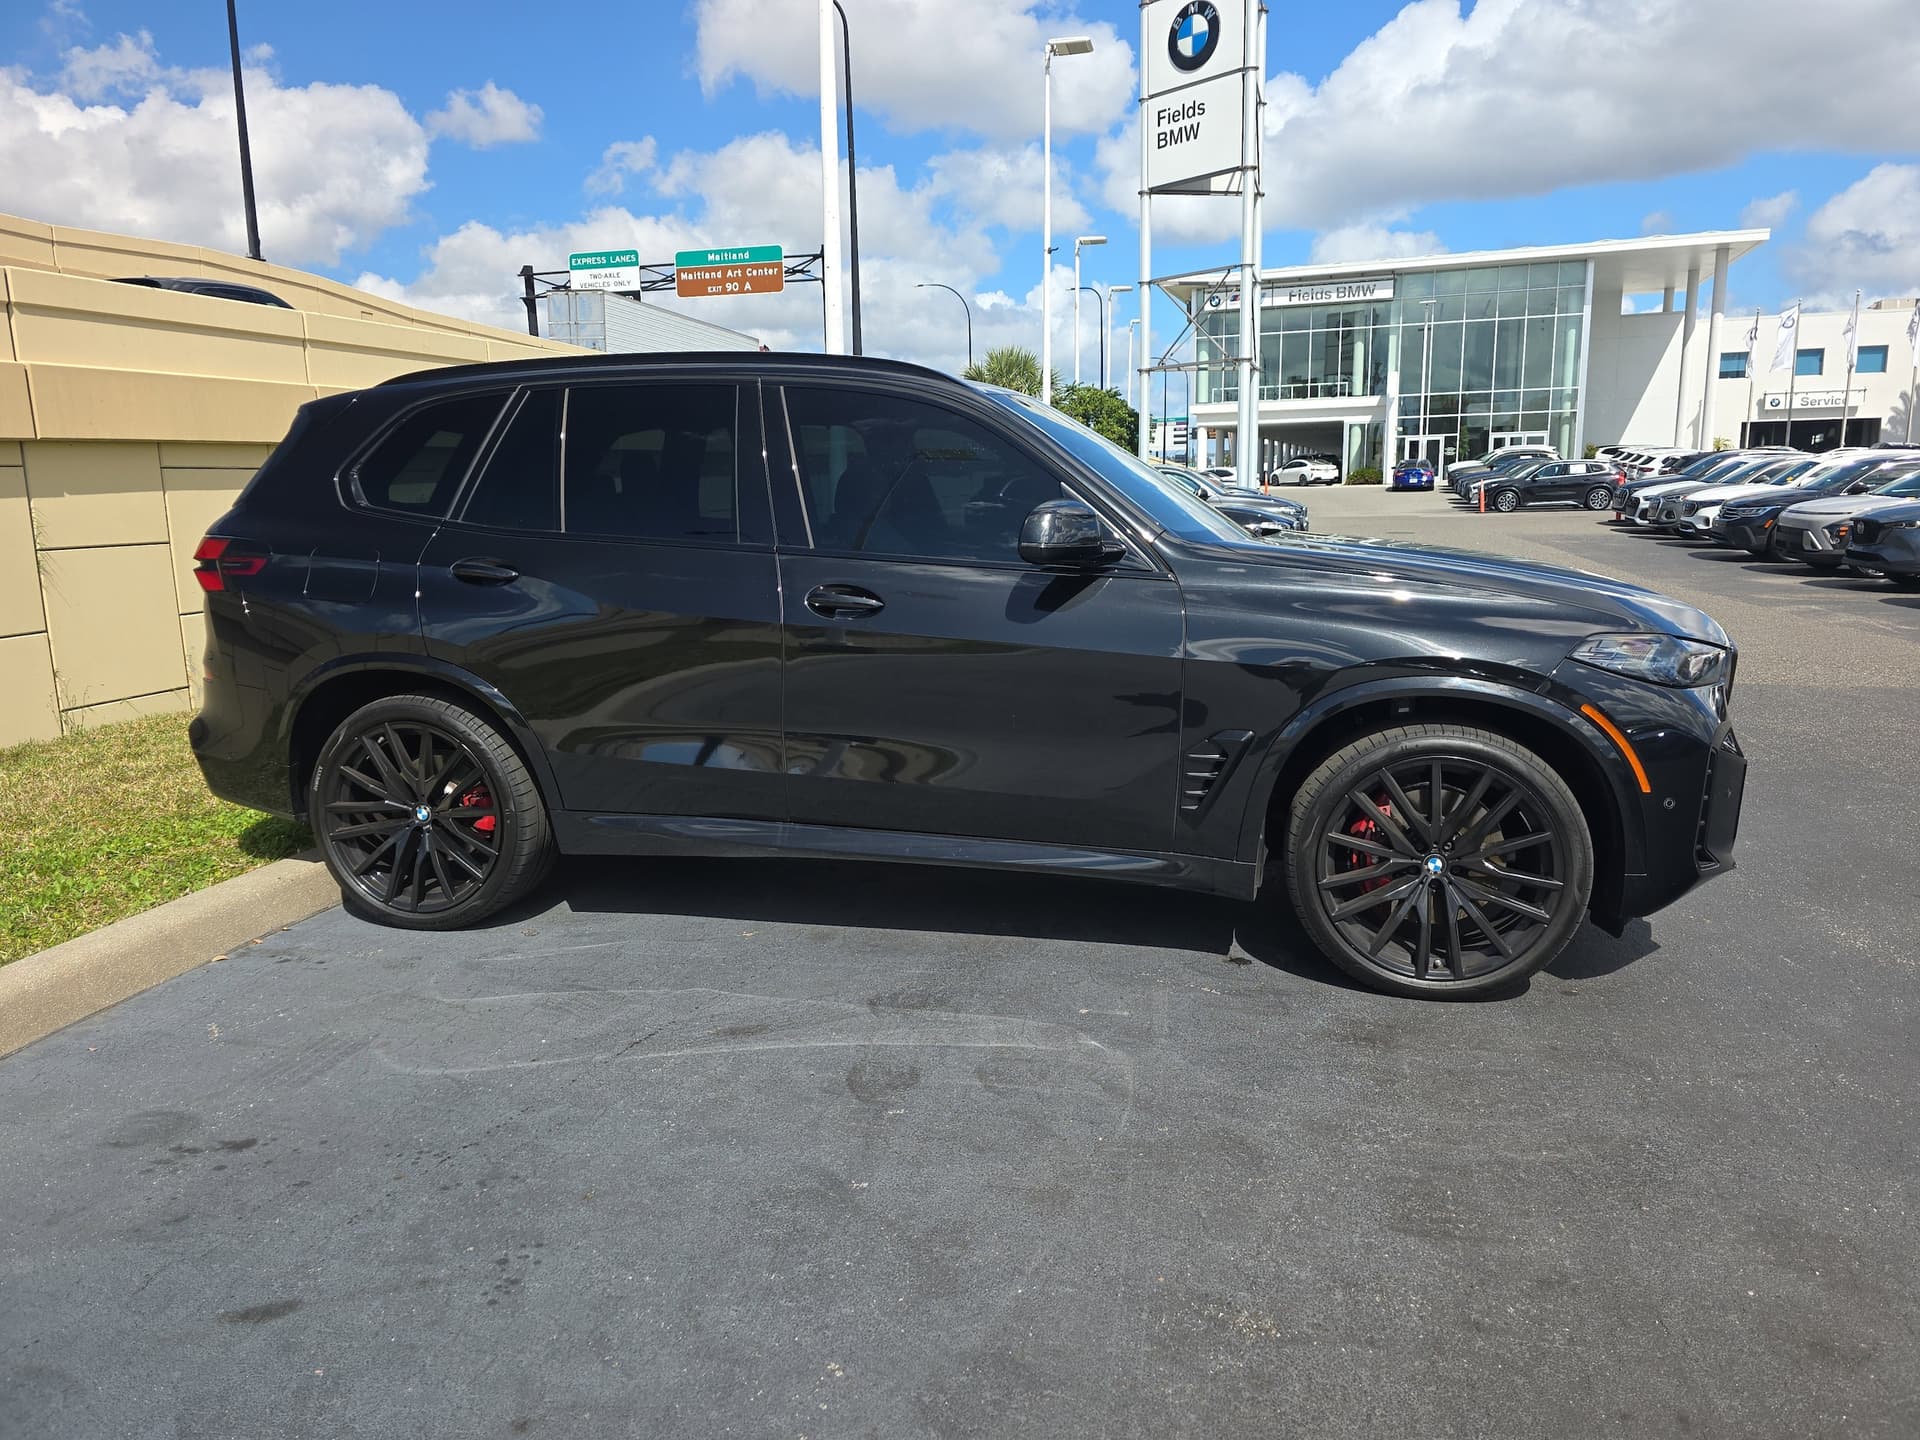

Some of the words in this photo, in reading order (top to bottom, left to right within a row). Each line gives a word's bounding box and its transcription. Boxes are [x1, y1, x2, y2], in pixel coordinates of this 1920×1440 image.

[1172, 1, 1216, 30] BMW
[1157, 100, 1206, 127] Fields
[1157, 122, 1200, 149] BMW
[571, 256, 606, 266] EXPRESS
[610, 254, 636, 264] LANES
[707, 251, 750, 261] Maitland
[680, 269, 722, 280] Maitland
[726, 268, 742, 278] Art
[746, 267, 778, 277] Center
[707, 285, 722, 293] EXIT
[725, 282, 739, 292] 90
[744, 281, 752, 291] A
[1288, 287, 1332, 302] Fields
[1336, 284, 1377, 299] BMW
